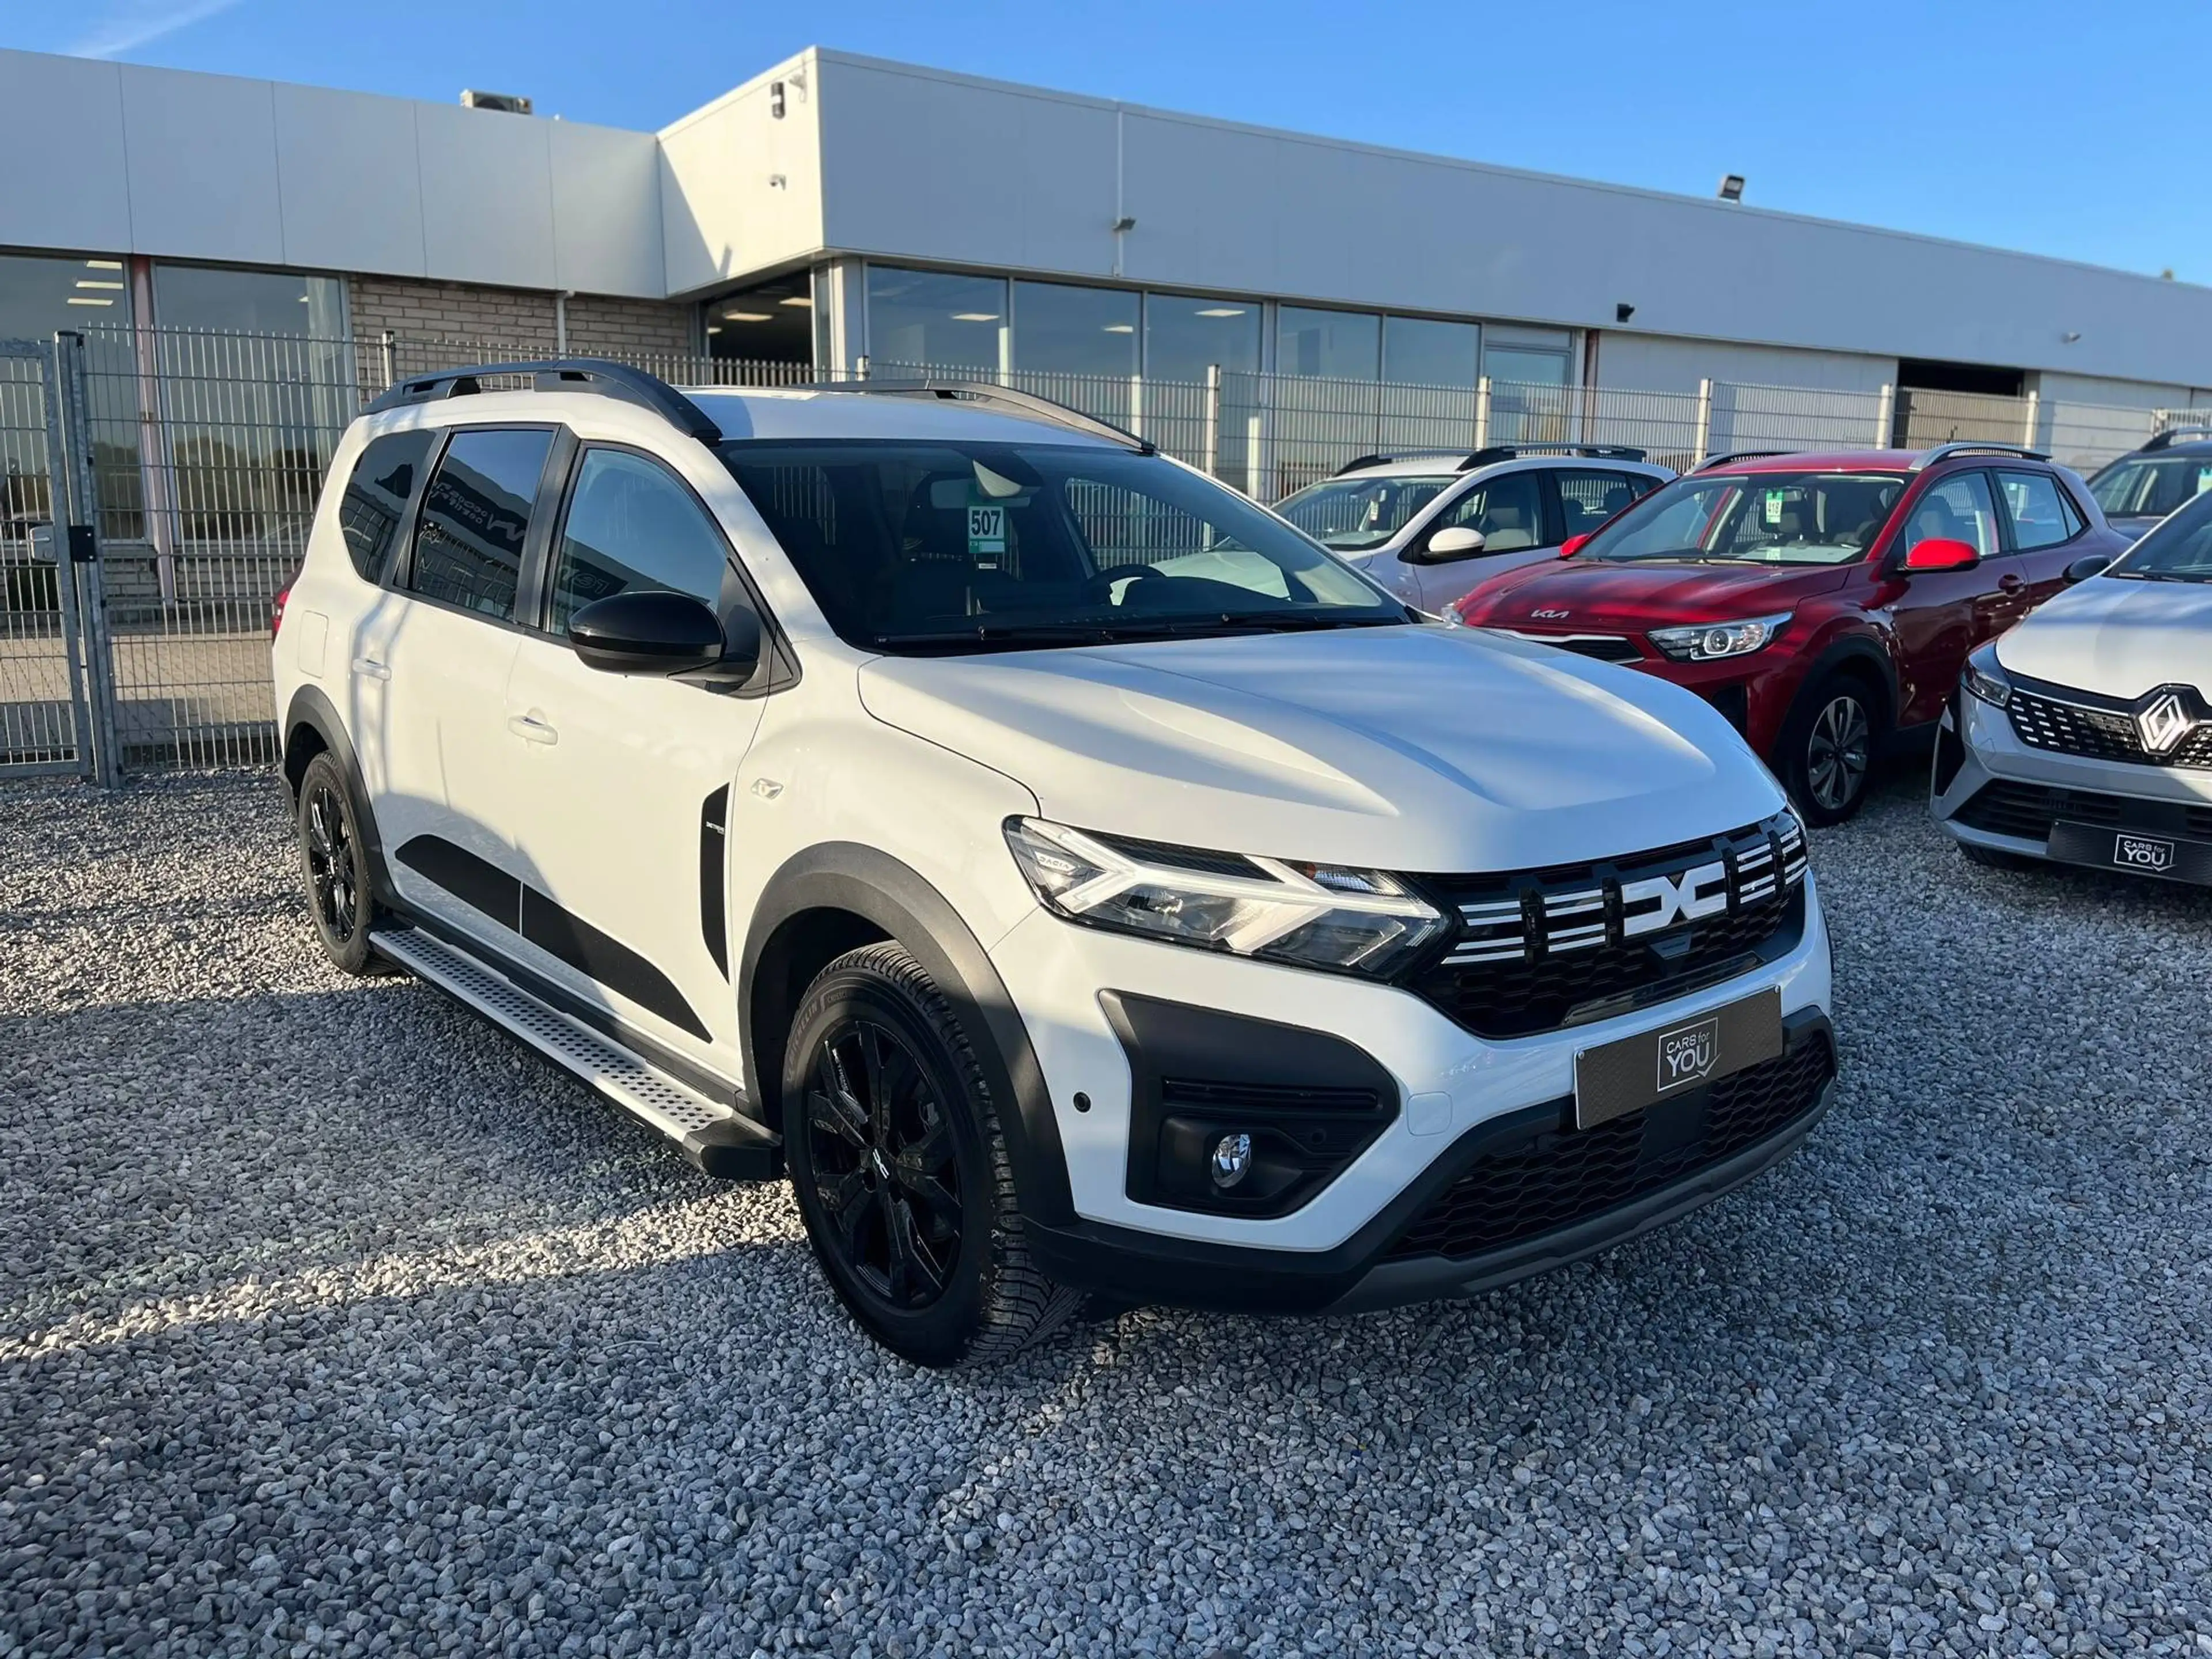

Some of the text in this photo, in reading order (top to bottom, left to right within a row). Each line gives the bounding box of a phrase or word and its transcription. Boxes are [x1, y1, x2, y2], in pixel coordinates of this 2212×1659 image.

[971, 510, 1001, 535] 507
[1531, 609, 1570, 619] KIA
[2124, 840, 2152, 851] CARS
[1039, 856, 1070, 869] DACIA
[2123, 847, 2165, 865] YOU
[1666, 1031, 1710, 1054] CARS for
[1666, 1042, 1709, 1077] YOU
